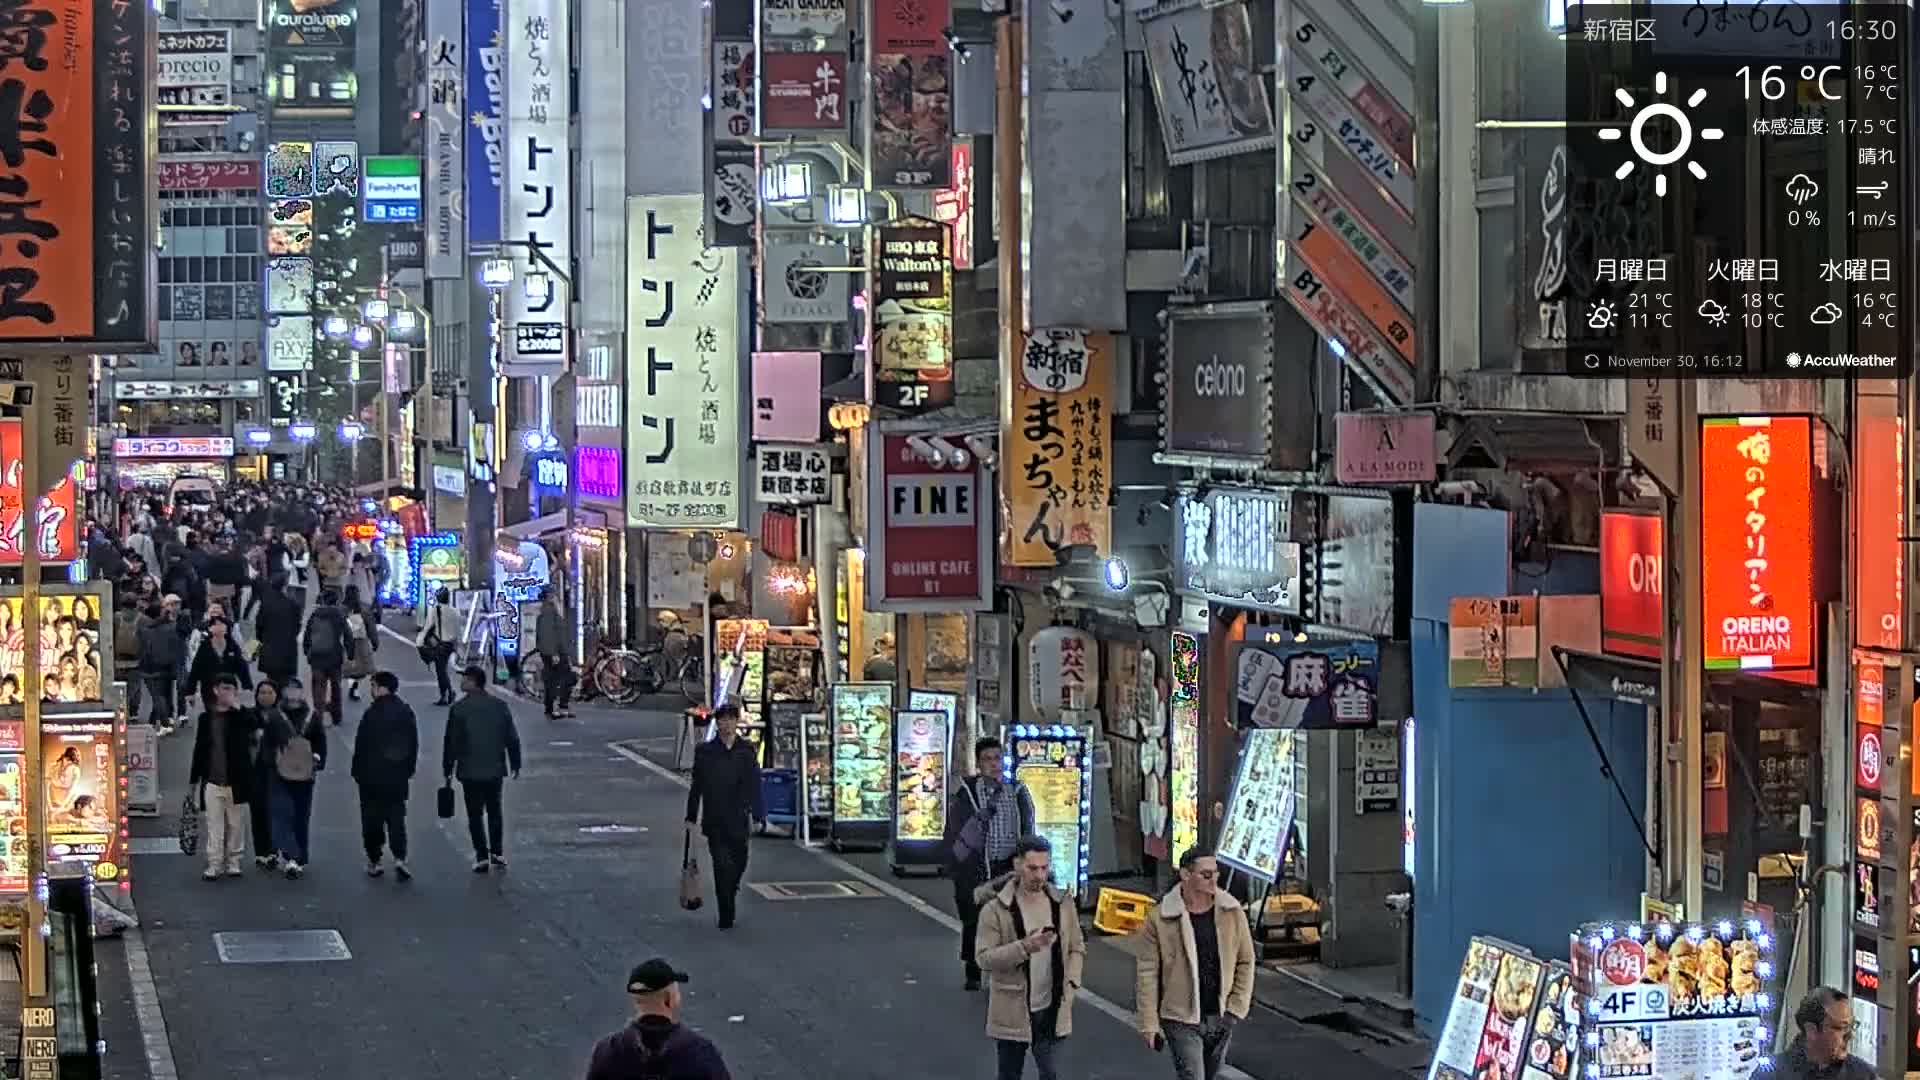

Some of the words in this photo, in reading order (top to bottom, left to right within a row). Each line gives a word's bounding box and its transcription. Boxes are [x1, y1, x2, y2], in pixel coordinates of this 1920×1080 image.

[277, 14, 351, 26] auralume
[1296, 23, 1317, 43] 5
[812, 61, 840, 121] 牛門
[1295, 75, 1316, 92] 4
[1297, 124, 1316, 144] 3
[367, 182, 418, 193] FamilyMart
[1295, 173, 1316, 195] 2
[1299, 222, 1315, 240] 1
[884, 256, 942, 273] Walton's
[1294, 269, 1321, 298] B1
[641, 209, 677, 464] トントン
[1026, 340, 1085, 376] 新宿
[1194, 353, 1246, 397] celona
[899, 386, 929, 406] 2F
[761, 451, 826, 473] 酒場心
[1022, 397, 1069, 552] まっちゃん
[761, 476, 826, 495] 新宿本店
[893, 485, 969, 515] FINE
[1736, 430, 1771, 606] 俺のイタリアン
[940, 561, 972, 575] CAFE
[1722, 616, 1790, 634] ORENO
[1722, 634, 1791, 652] ITALIAN
[1285, 653, 1374, 722] 麻雀
[1602, 991, 1637, 1014] 4F
[23, 1007, 55, 1027] NERO
[26, 1040, 57, 1058] NERO
